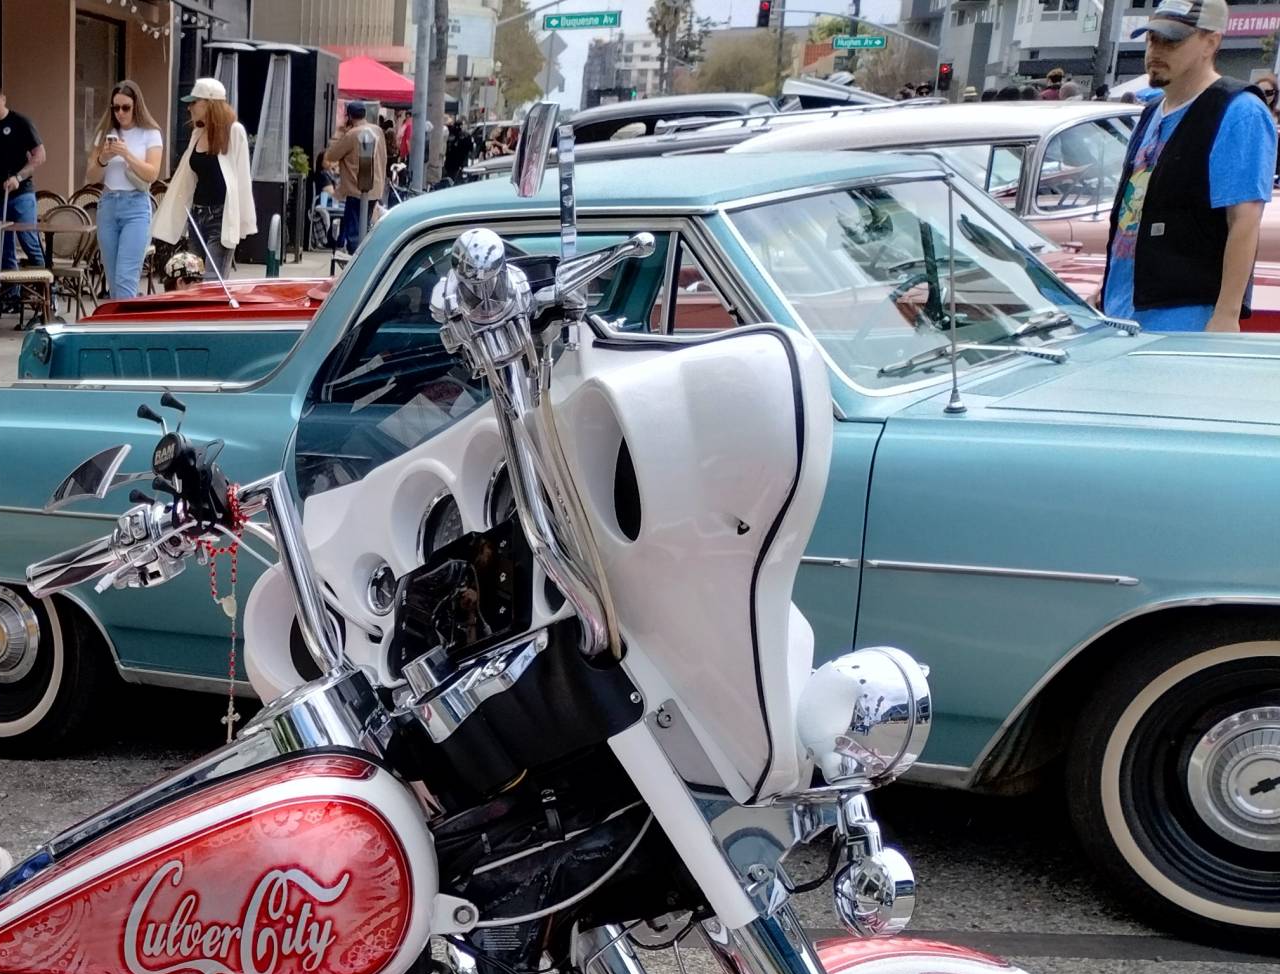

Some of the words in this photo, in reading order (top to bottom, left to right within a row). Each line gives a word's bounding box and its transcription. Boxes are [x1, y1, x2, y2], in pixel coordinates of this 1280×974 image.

[560, 17, 600, 27] Duquesne
[603, 15, 615, 25] Av
[863, 38, 873, 46] Av
